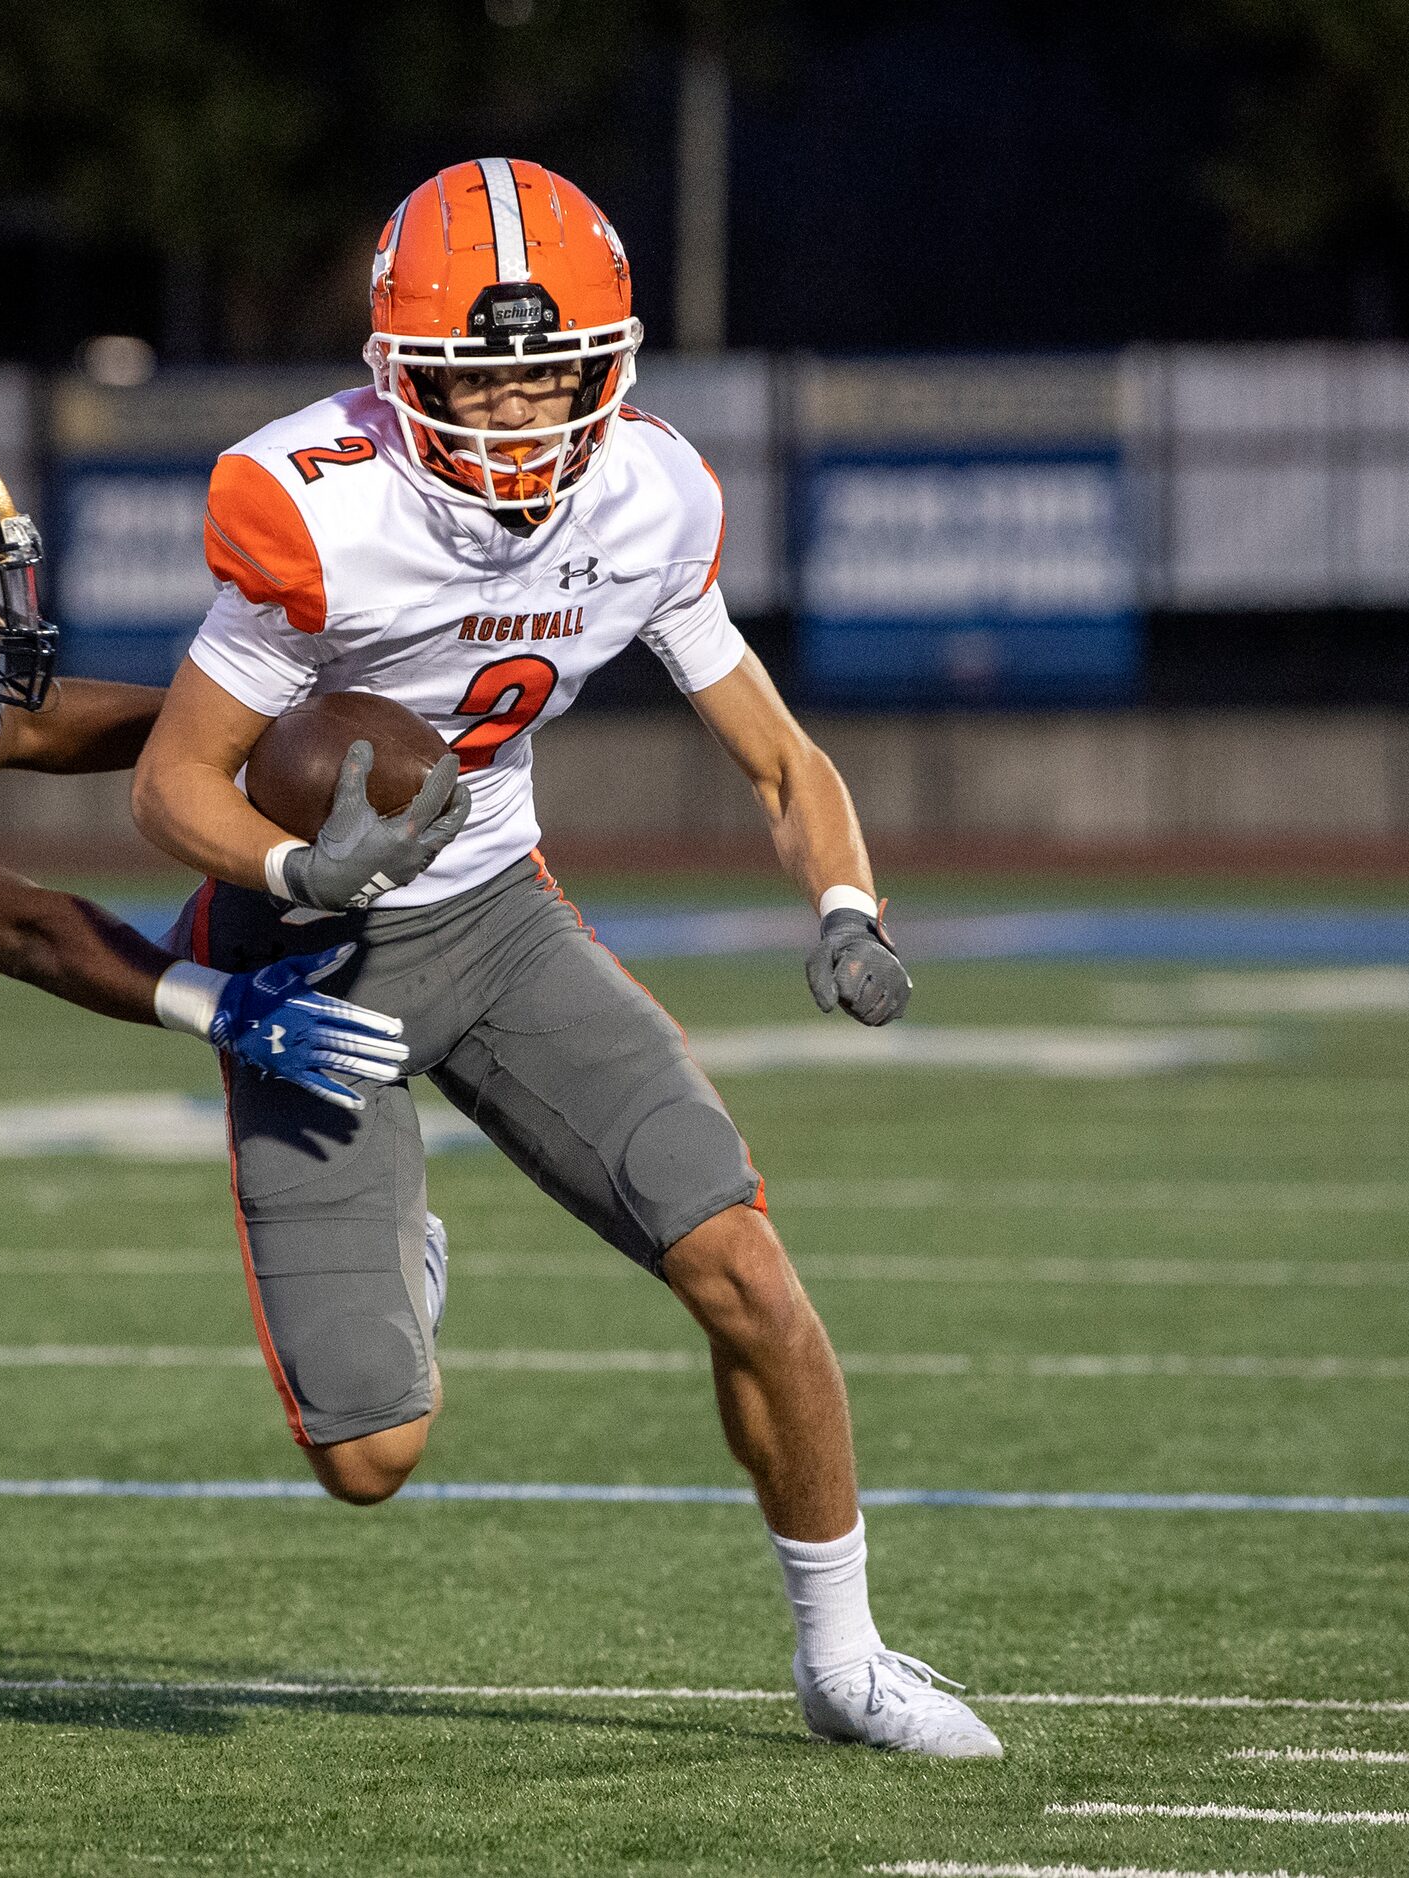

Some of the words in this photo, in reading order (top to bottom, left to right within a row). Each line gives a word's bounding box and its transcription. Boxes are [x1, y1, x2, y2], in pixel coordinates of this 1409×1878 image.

[287, 436, 377, 485] 2
[458, 606, 584, 642] ROCKWALL
[449, 653, 559, 777] 2
